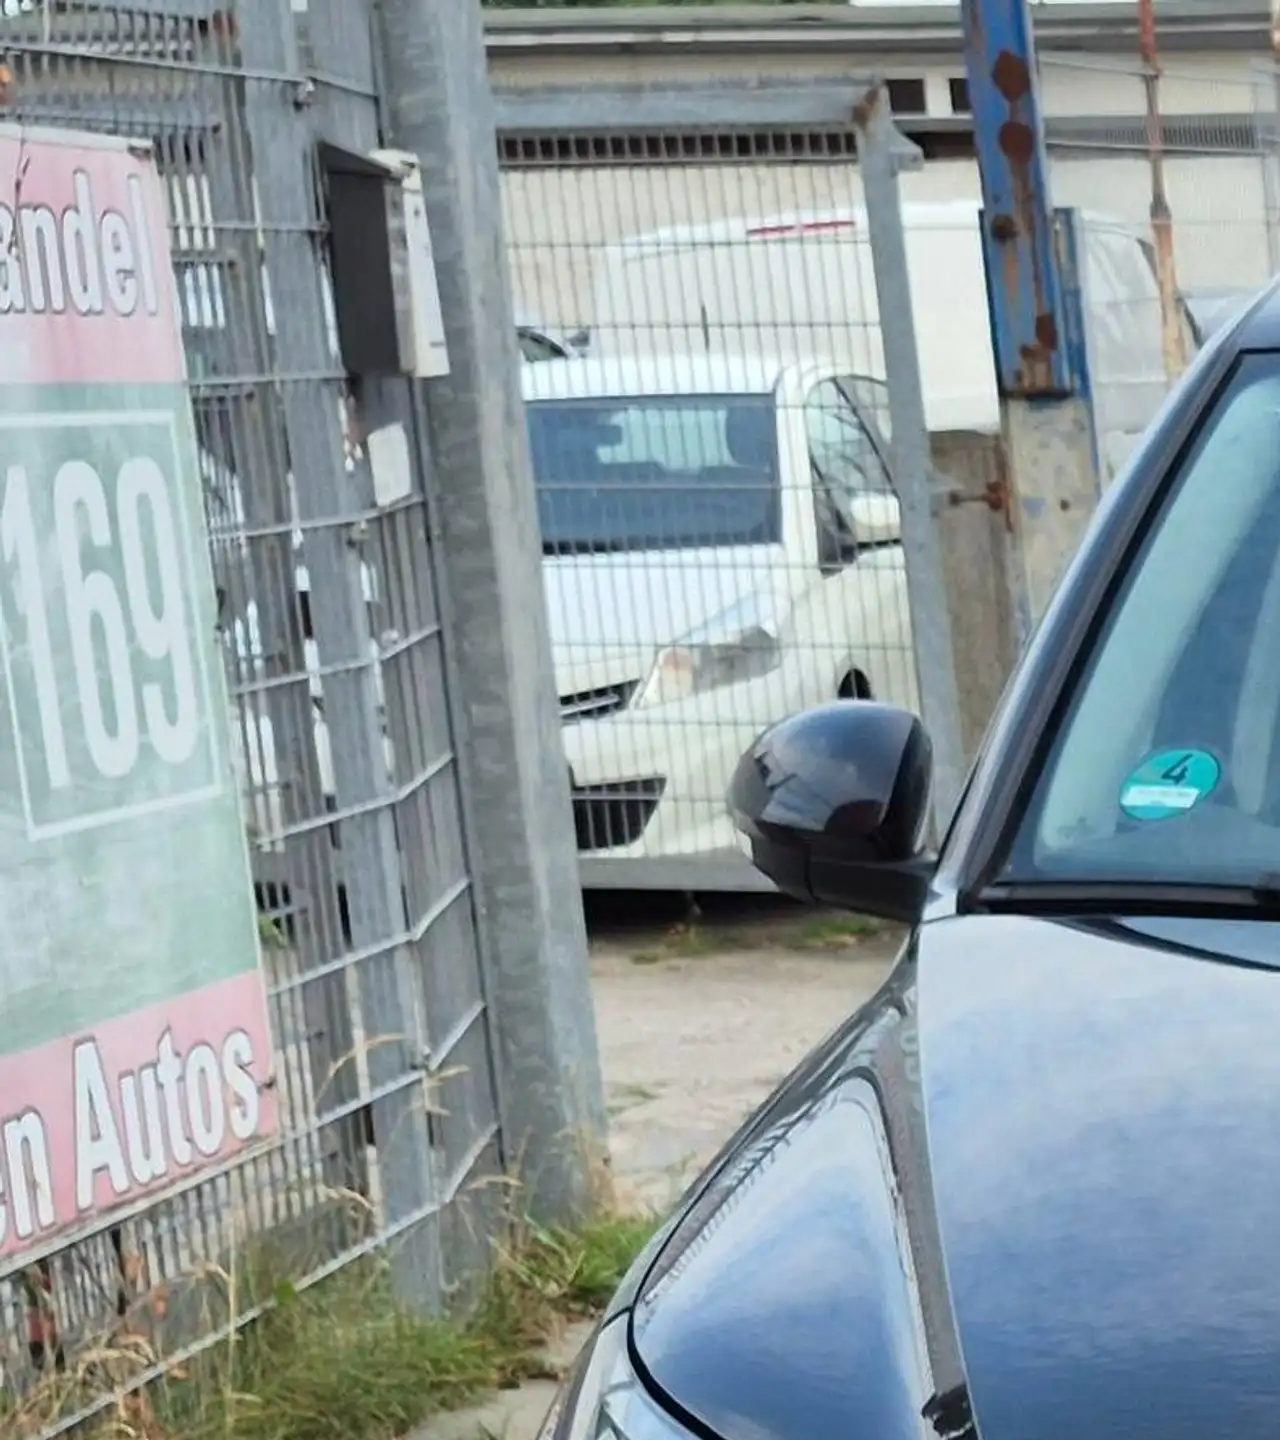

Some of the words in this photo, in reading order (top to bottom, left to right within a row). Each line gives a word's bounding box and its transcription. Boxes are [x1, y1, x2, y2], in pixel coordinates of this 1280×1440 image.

[1, 456, 198, 787] 169
[1161, 753, 1194, 785] 4
[73, 1025, 261, 1213] Autos
